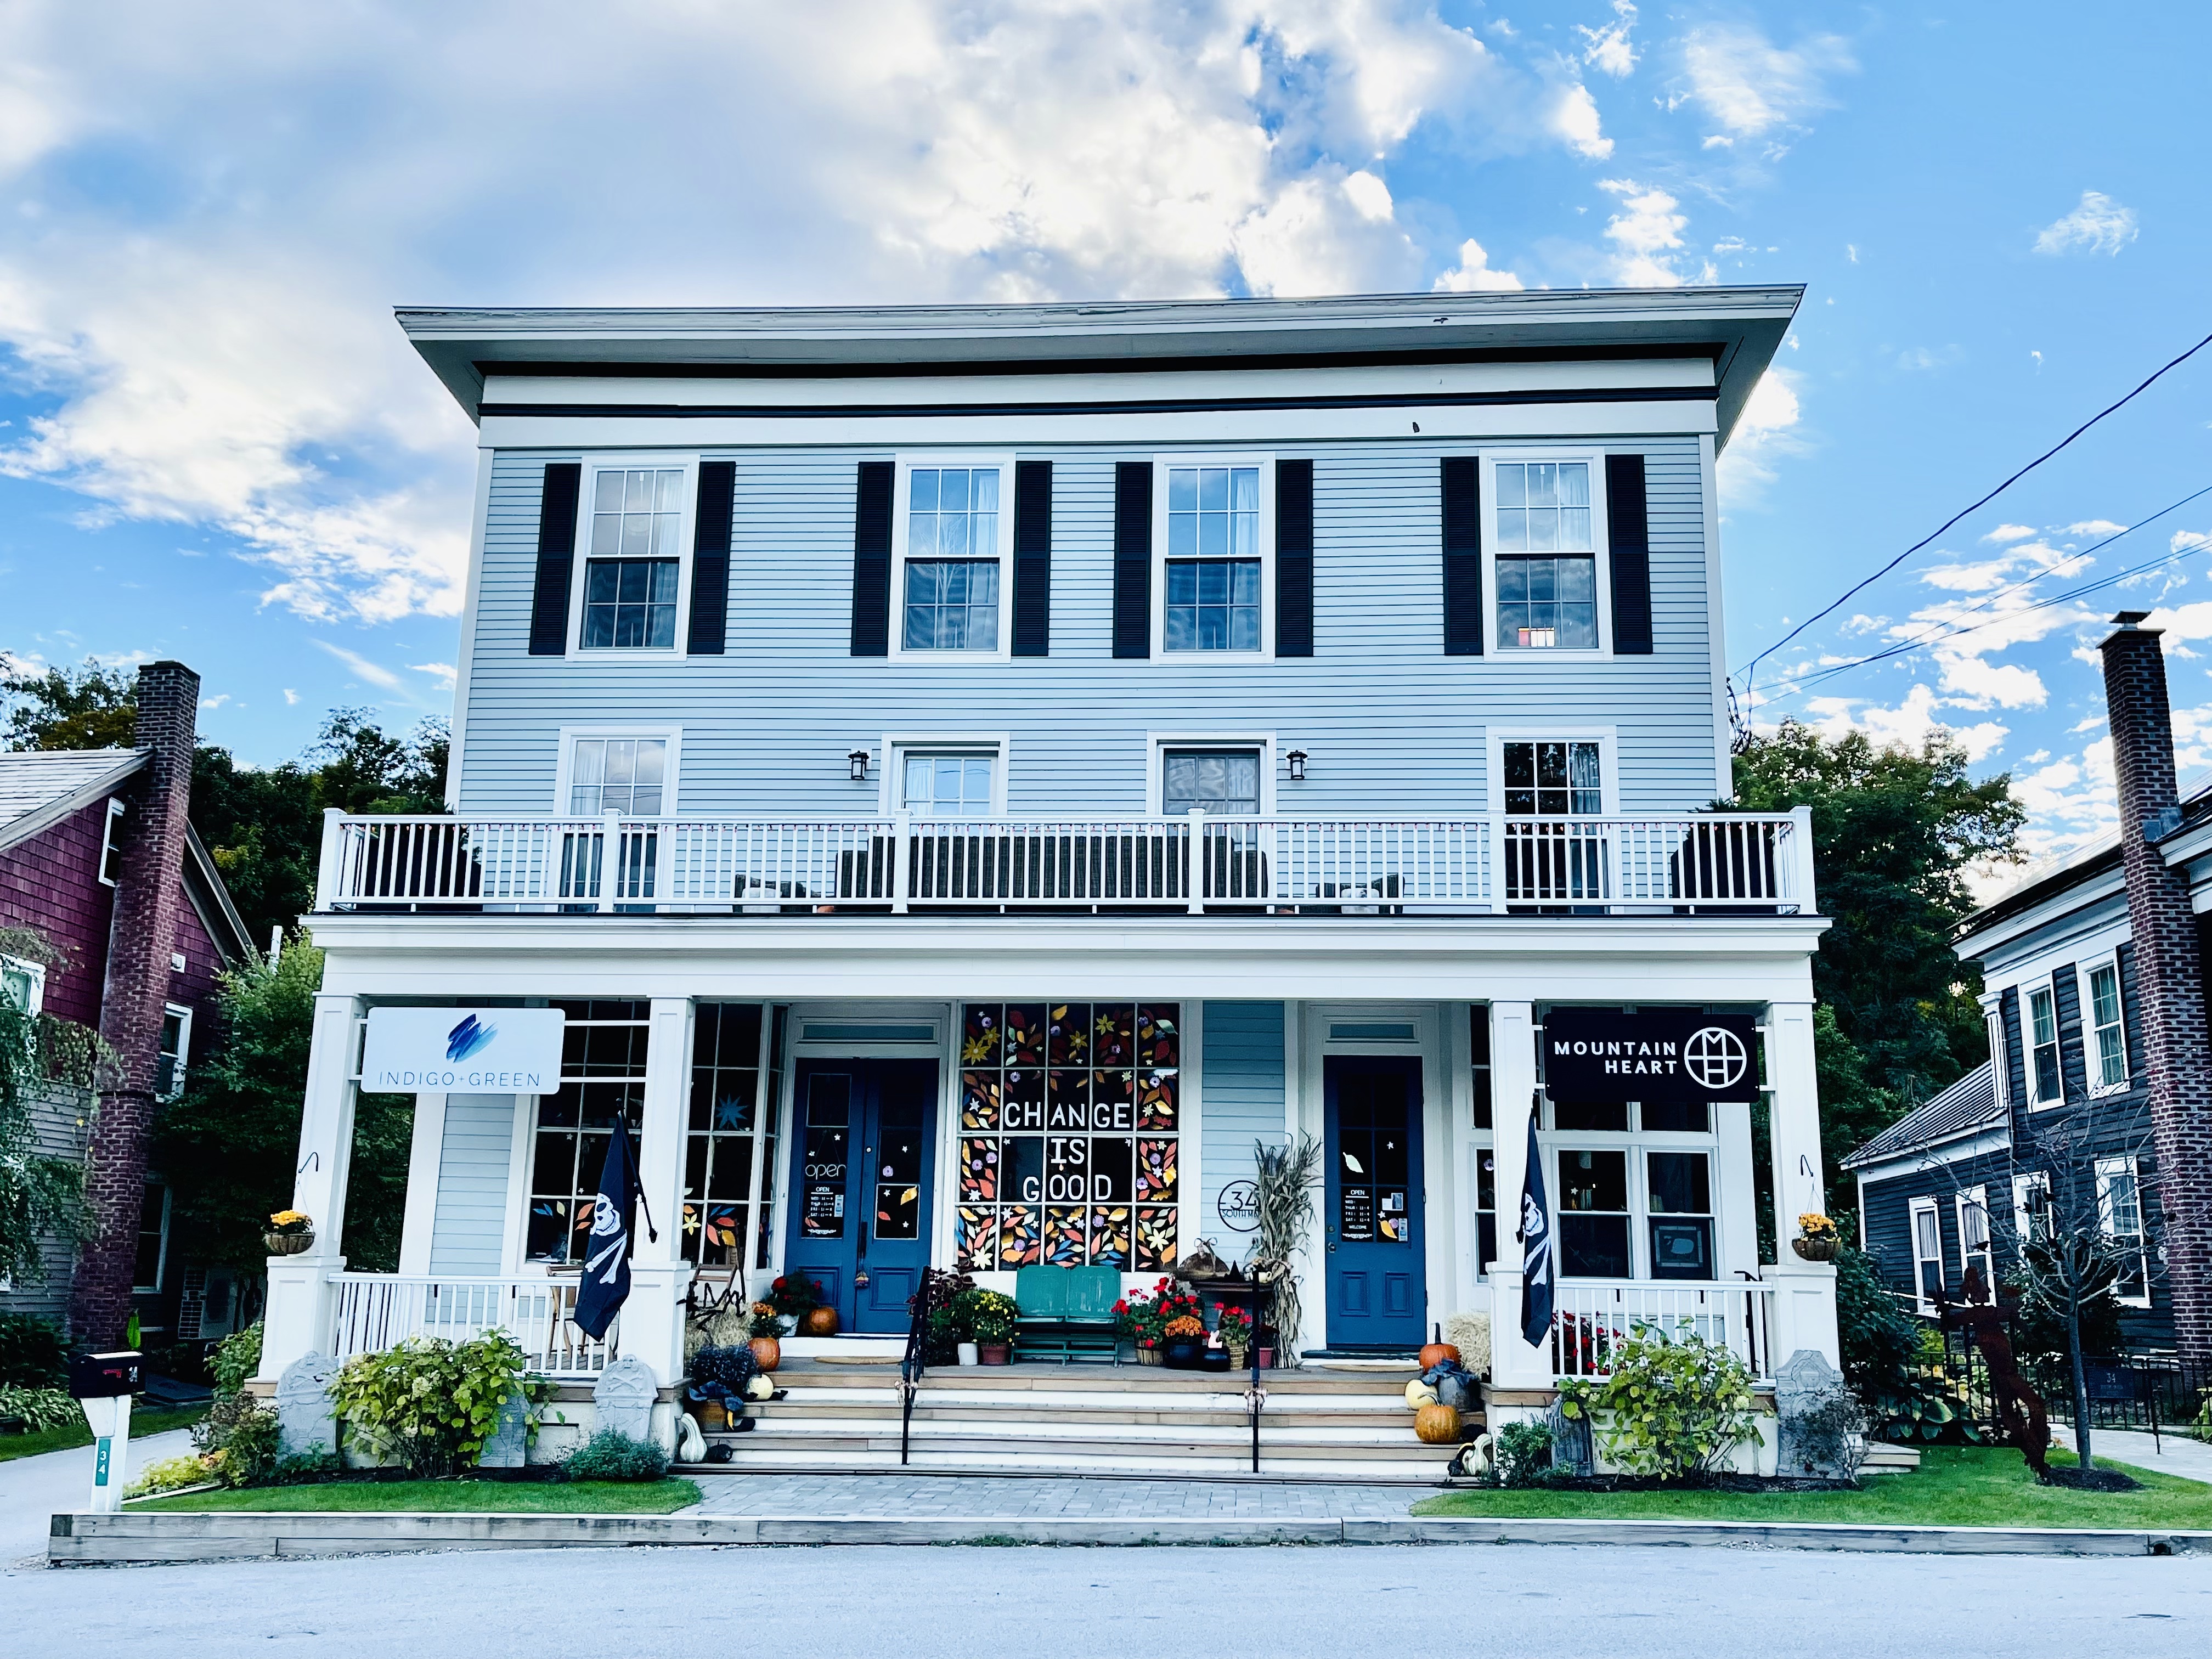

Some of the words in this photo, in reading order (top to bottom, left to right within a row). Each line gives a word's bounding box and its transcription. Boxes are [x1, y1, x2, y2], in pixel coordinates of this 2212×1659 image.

[1554, 1041, 1676, 1056] MOUNTAIN
[1605, 1060, 1677, 1074] HEART
[1004, 1102, 1130, 1128] CHANGE
[1050, 1138, 1085, 1164] IS
[1022, 1174, 1111, 1201] GOOD
[1230, 1191, 1257, 1210] 34
